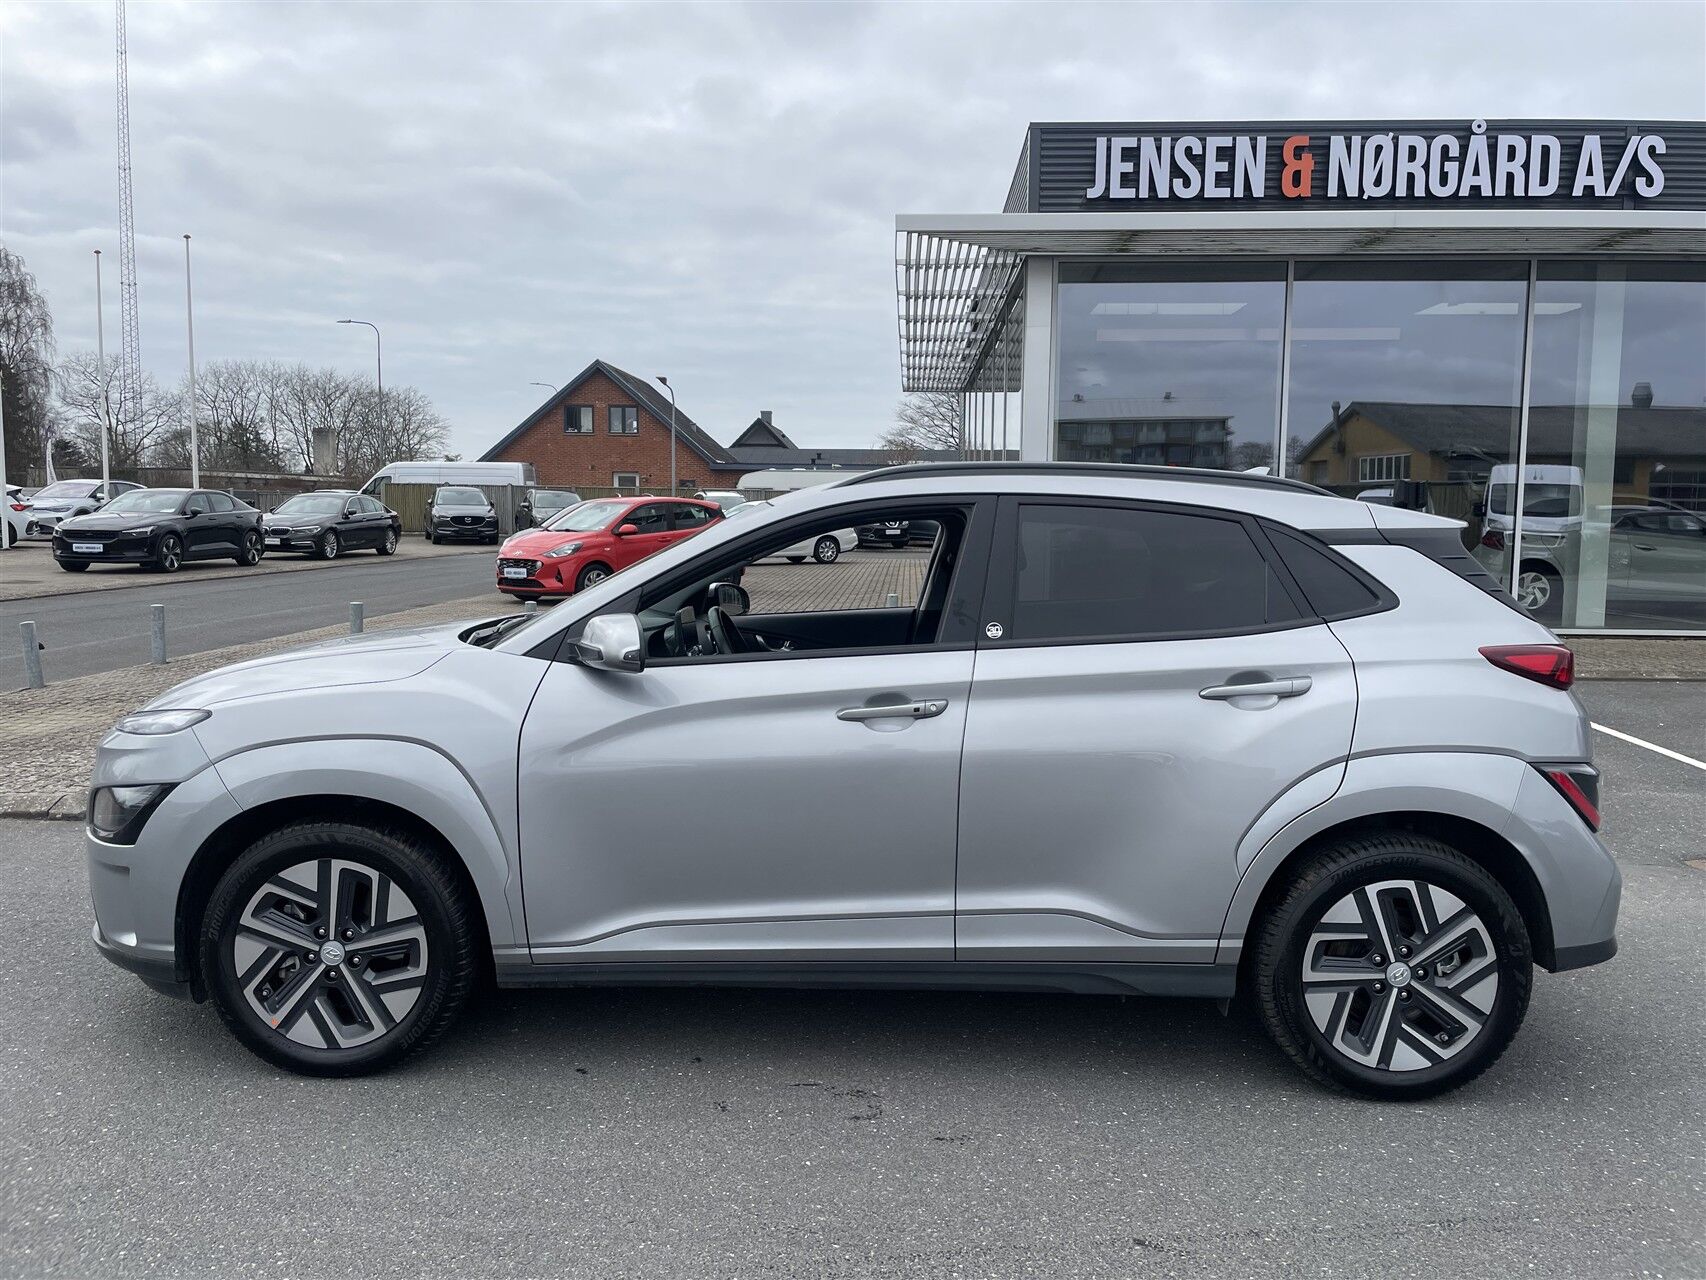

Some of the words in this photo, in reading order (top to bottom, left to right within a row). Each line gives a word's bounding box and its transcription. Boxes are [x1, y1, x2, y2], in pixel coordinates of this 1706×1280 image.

[1086, 135, 1268, 199] JENSEN
[1281, 135, 1315, 198] &
[1327, 118, 1561, 200] NØRGÅRD
[1572, 134, 1667, 198] A/S
[400, 968, 449, 1050] BRIDGESTONE
